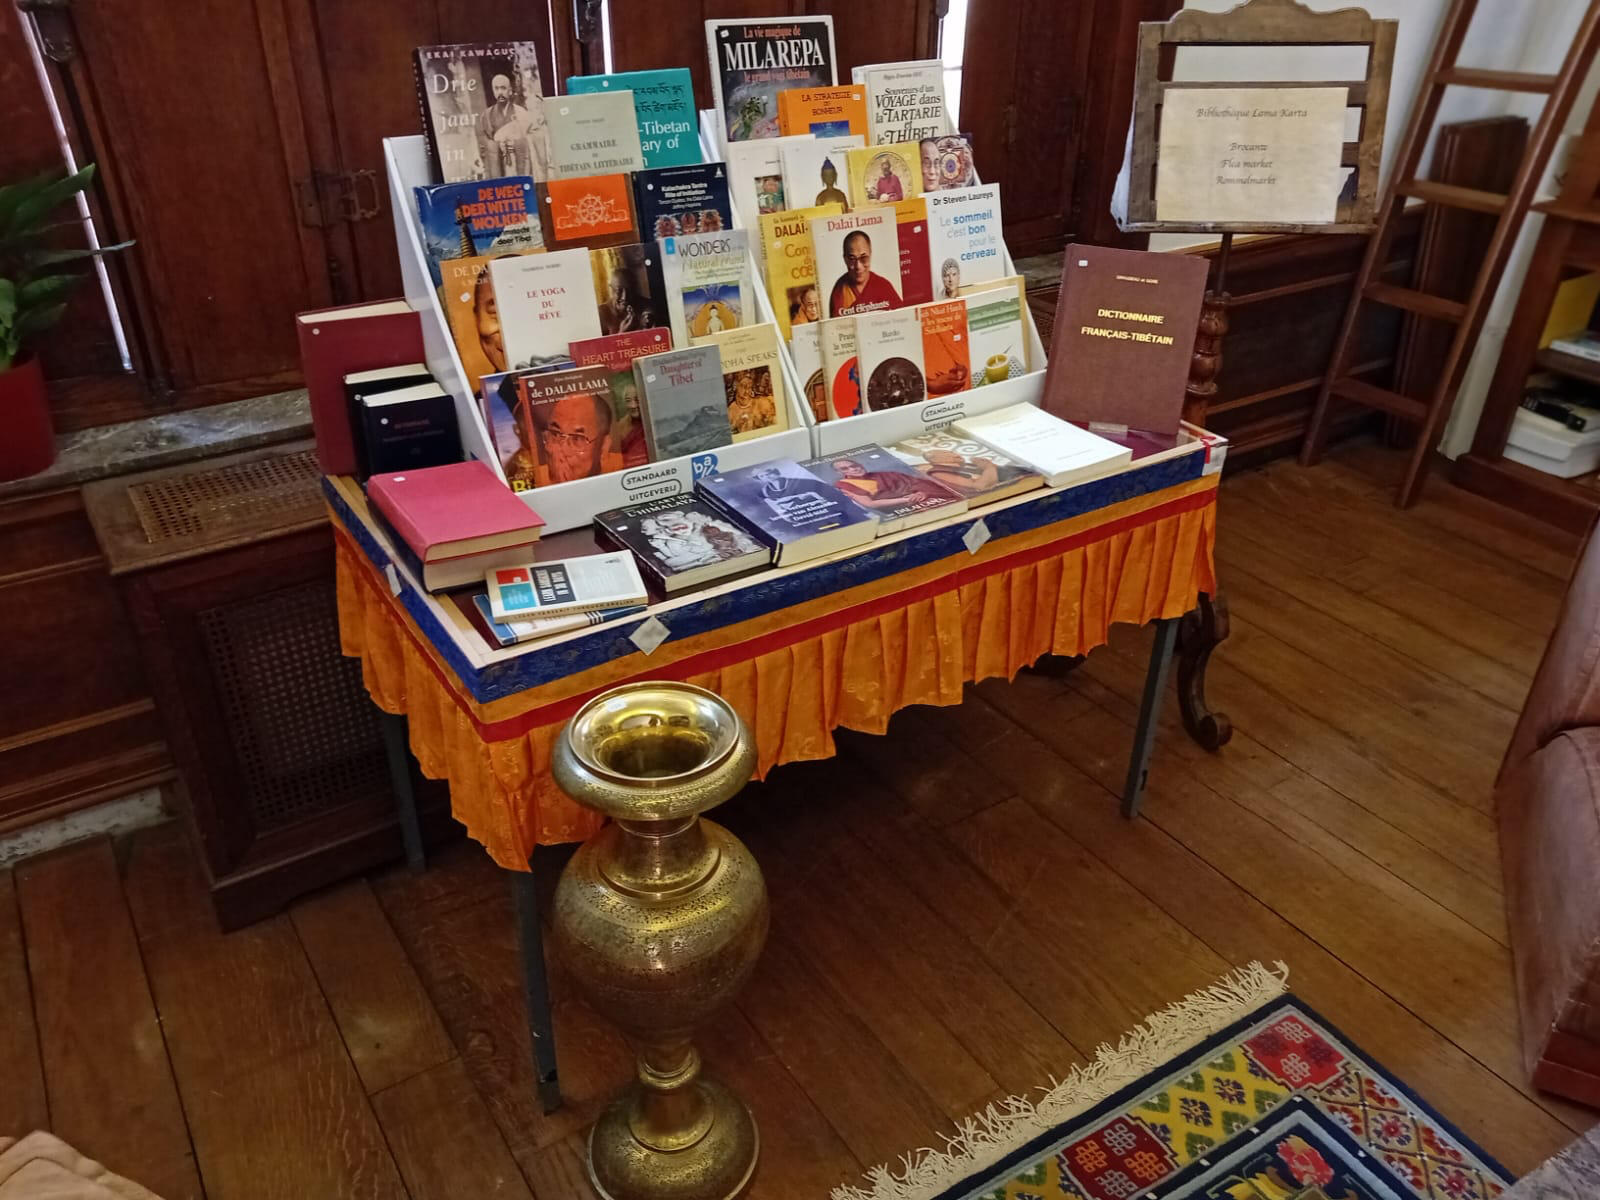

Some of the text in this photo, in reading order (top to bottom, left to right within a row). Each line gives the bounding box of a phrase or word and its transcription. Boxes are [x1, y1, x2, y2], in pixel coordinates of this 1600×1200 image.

[460, 48, 516, 58] KAWAGUC
[723, 38, 825, 71] MILAREPA
[432, 73, 477, 94] Drie
[875, 94, 941, 109] VOYAGE dans
[440, 111, 479, 133] jaar
[875, 106, 942, 124] la TARTARIE
[638, 121, 690, 135] -Tibetan
[642, 134, 679, 153] ary of
[478, 184, 523, 200] DE WEG
[933, 191, 994, 206] Dr Steven Laureys
[462, 198, 525, 217] DER WITTE
[472, 213, 528, 230] WOLKEN
[856, 215, 883, 228] Lama
[953, 209, 993, 225] sommeil
[968, 225, 986, 235] bon
[678, 238, 731, 257] WONDERS
[960, 247, 997, 261] cerveau
[454, 266, 470, 278] DE
[527, 287, 566, 299] LE YOGA
[542, 301, 554, 309] DU
[1097, 308, 1164, 324] DICTIONNAIRE
[616, 338, 632, 346] THE
[1081, 326, 1174, 345] FRANÇAIS-TIBÉTAIN
[582, 342, 668, 365] HEART TREASURE
[531, 389, 544, 399] de
[545, 384, 577, 397] DALAI
[579, 378, 609, 390] LAMA
[925, 402, 965, 417] STANDAARD
[626, 467, 677, 485] STANDAARD
[629, 485, 677, 501] UITGEVERIJ
